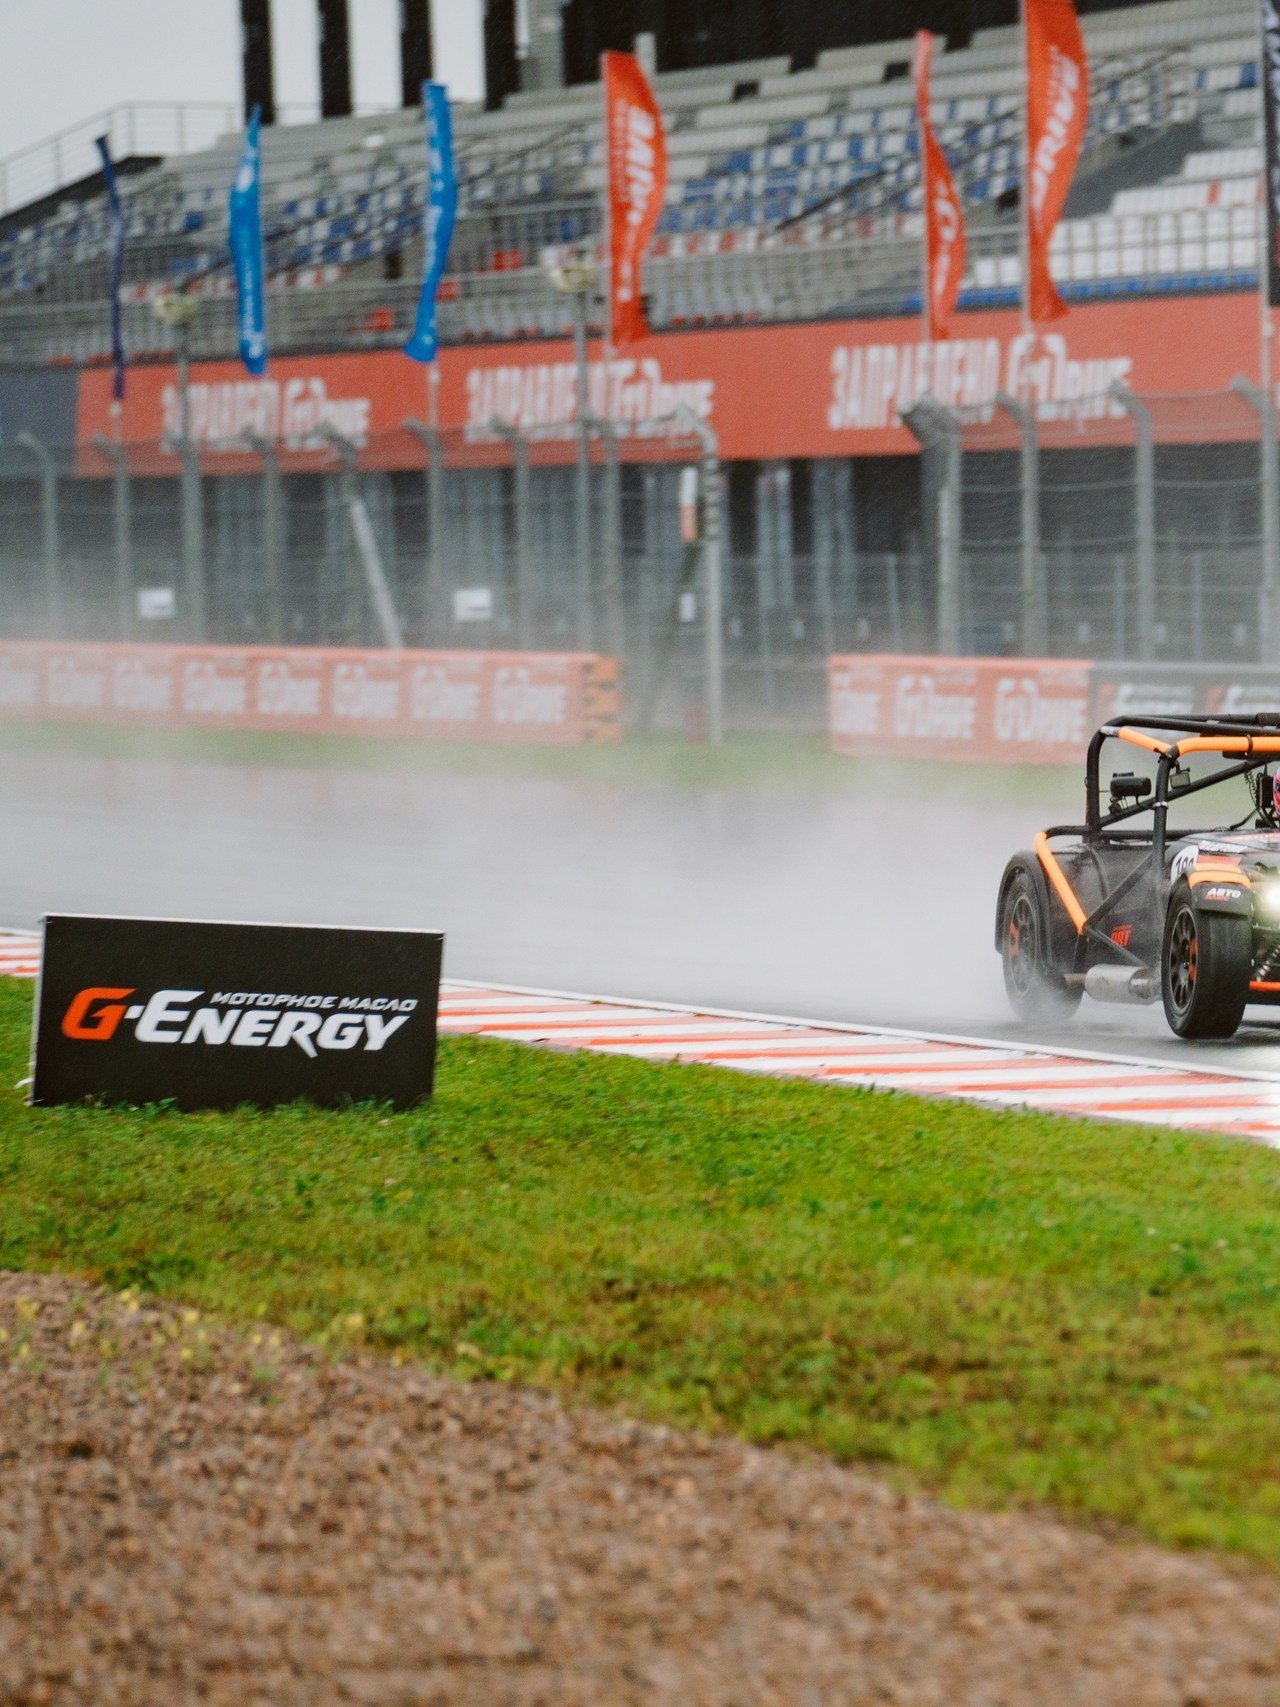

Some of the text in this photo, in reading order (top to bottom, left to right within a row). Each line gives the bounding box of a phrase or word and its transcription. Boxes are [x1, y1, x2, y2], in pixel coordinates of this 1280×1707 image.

[61, 987, 411, 1058] G-ENERGY
[209, 991, 419, 1012] МОТОРНОЕ МАСЛО
